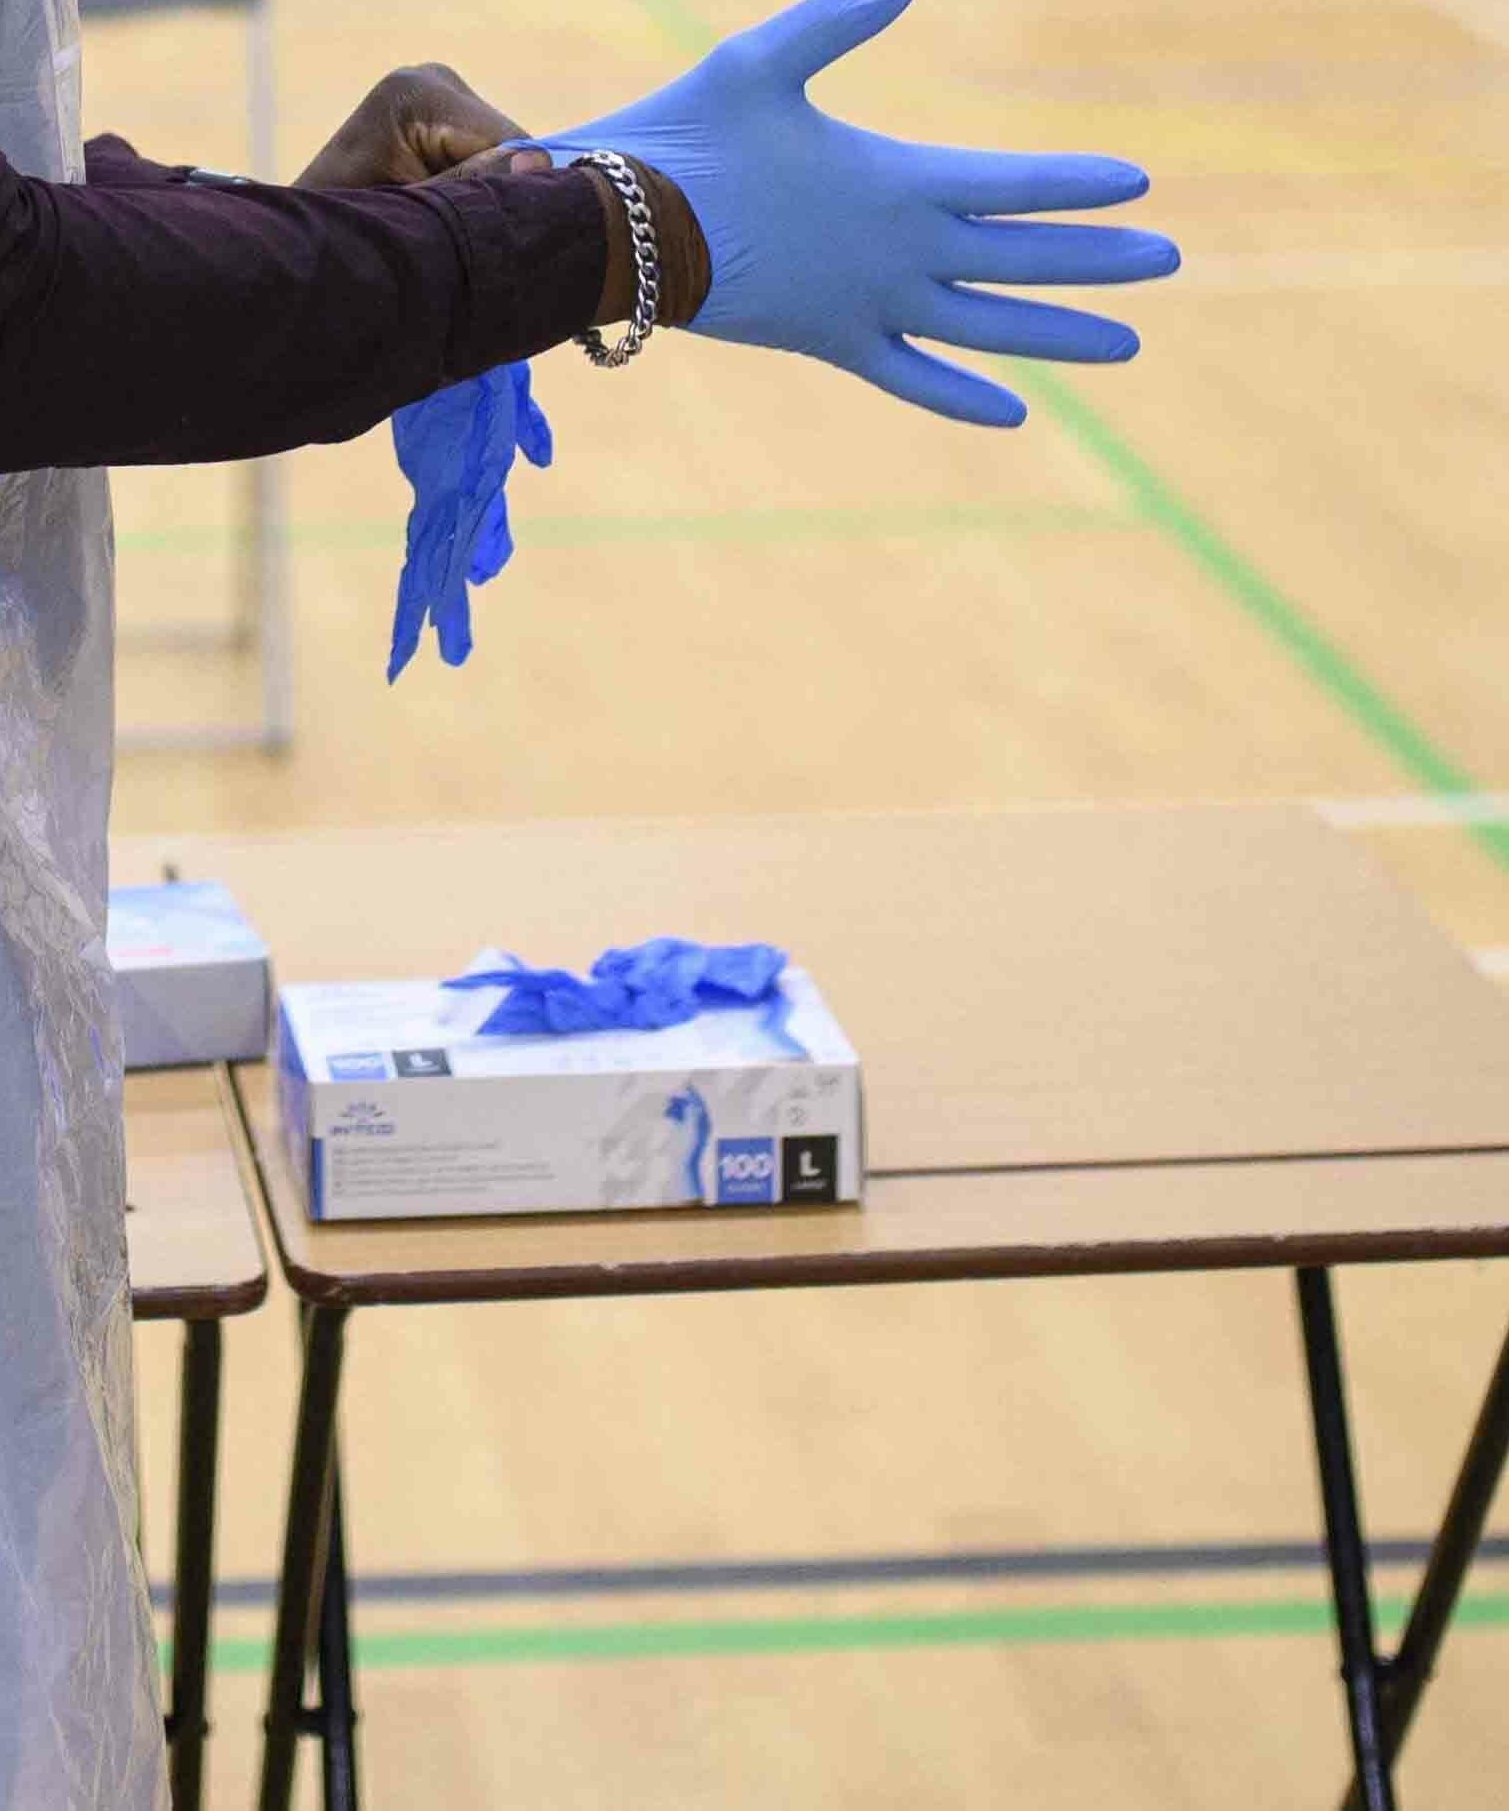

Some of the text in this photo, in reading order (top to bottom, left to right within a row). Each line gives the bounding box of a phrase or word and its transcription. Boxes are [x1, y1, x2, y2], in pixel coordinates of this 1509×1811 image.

[409, 1052, 433, 1068] L
[721, 1153, 773, 1181] 100
[800, 1150, 822, 1177] L
